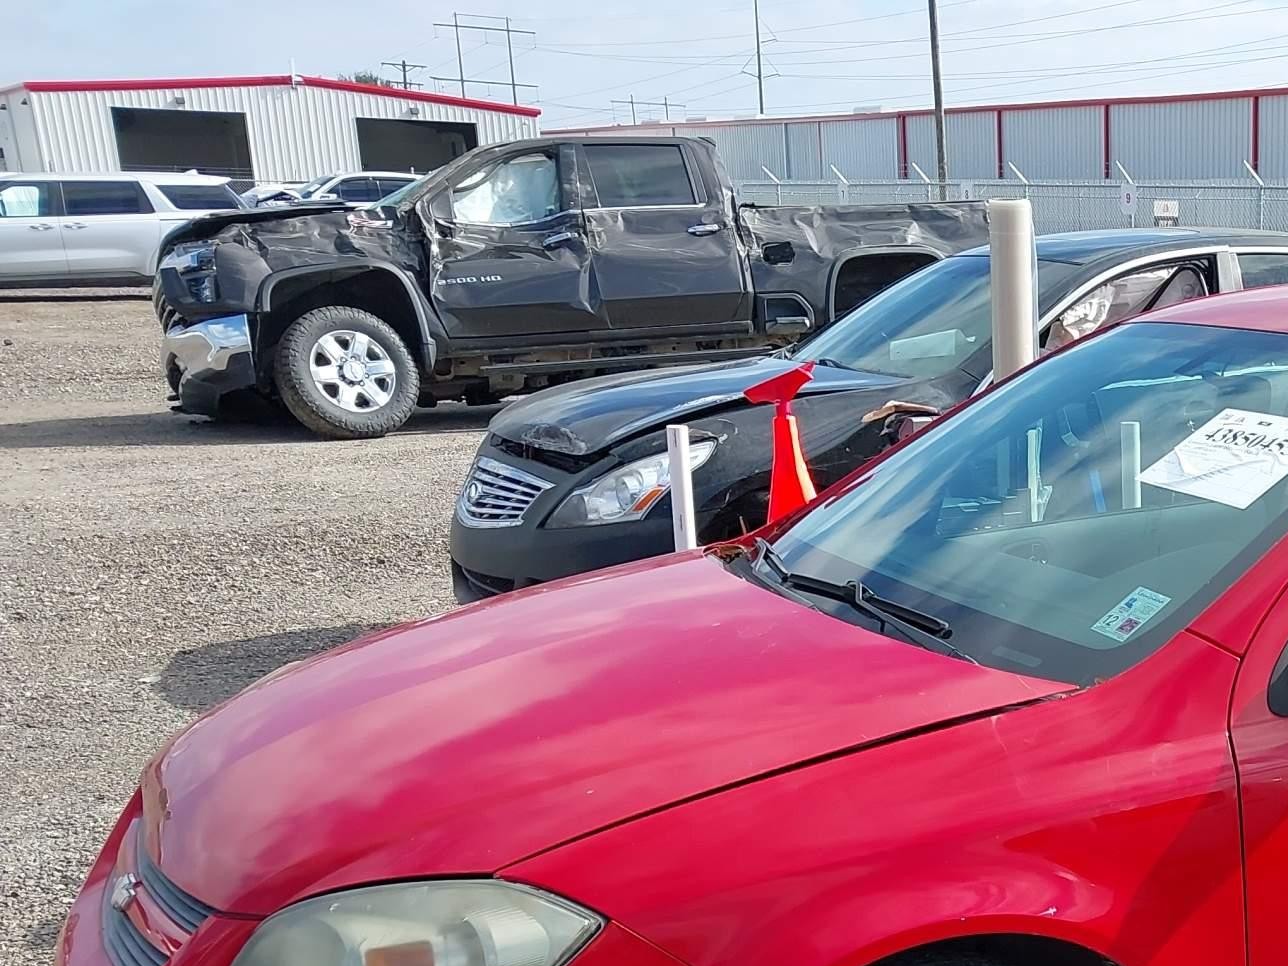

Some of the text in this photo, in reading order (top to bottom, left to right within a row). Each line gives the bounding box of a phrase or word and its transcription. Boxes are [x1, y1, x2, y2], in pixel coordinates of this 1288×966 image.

[1125, 192, 1131, 204] 9
[436, 274, 502, 286] 2500 HD
[1102, 614, 1119, 626] 12
